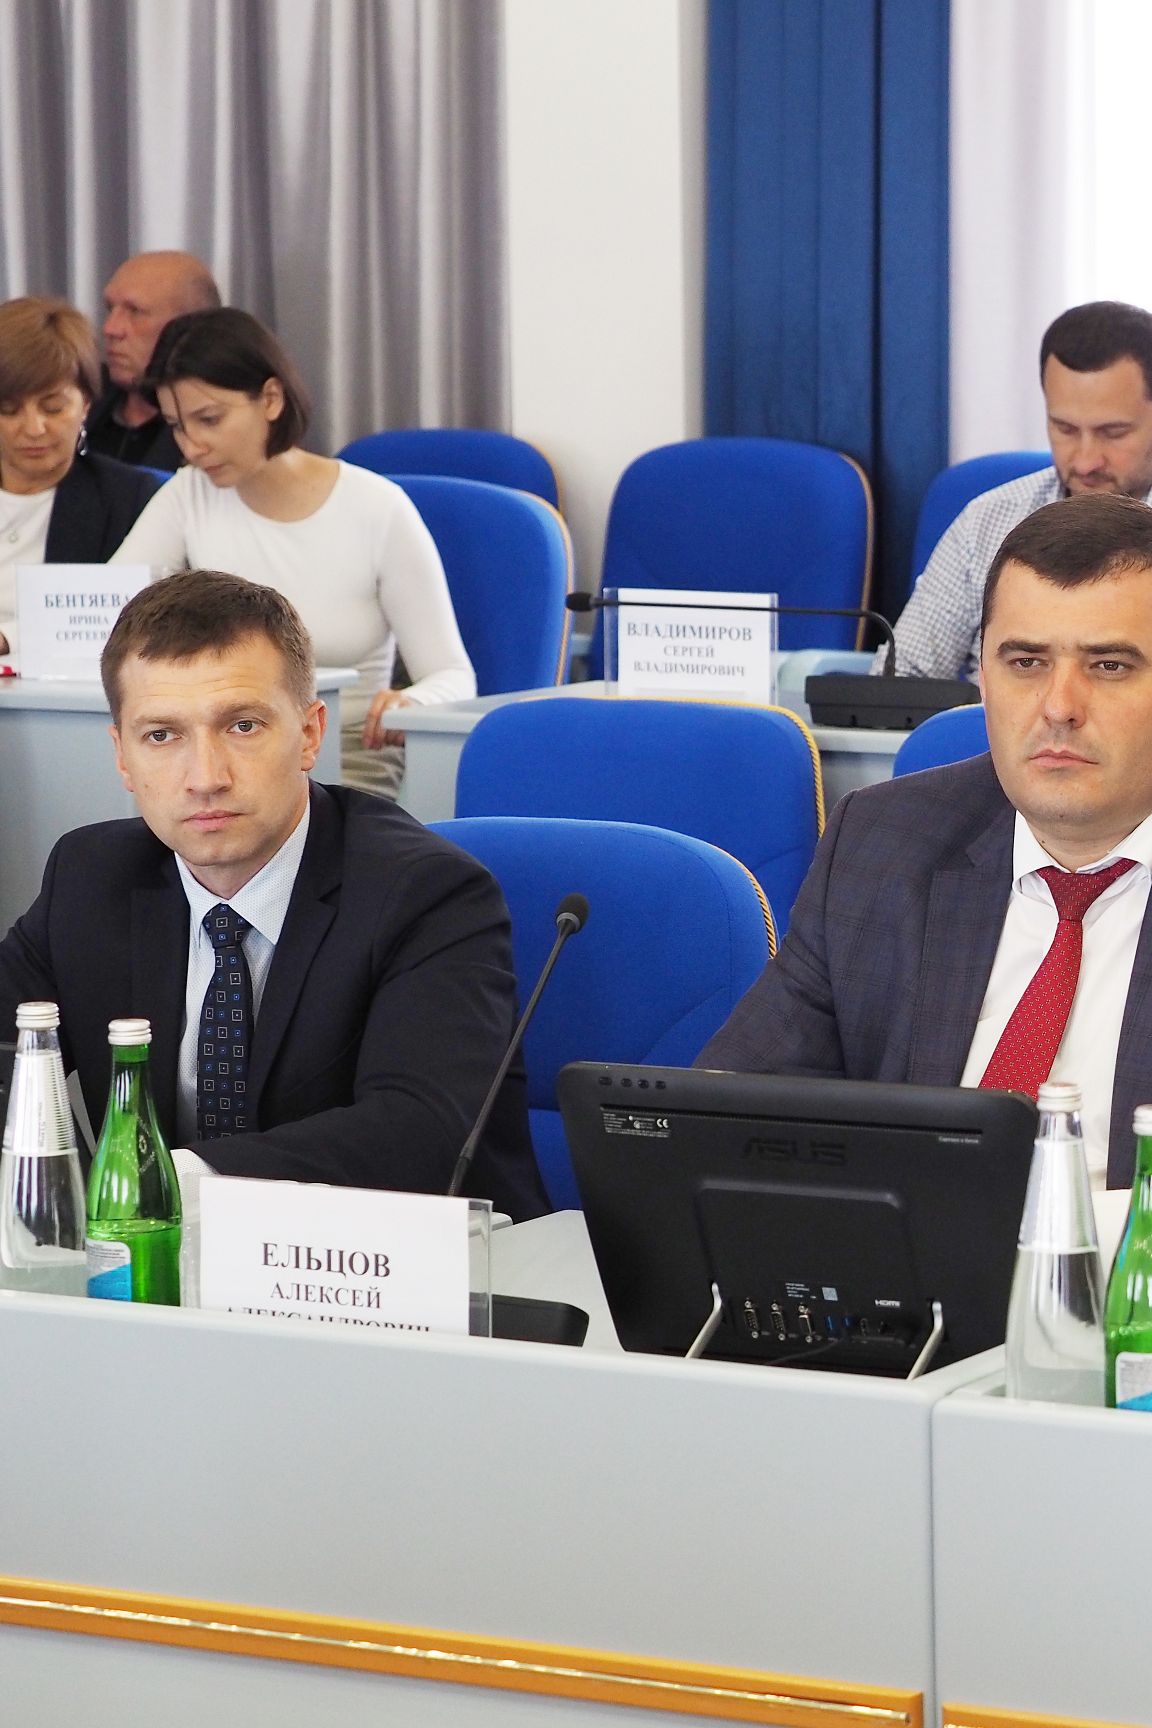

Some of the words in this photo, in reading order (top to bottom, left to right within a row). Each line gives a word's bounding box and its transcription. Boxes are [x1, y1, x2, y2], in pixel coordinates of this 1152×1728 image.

[69, 615, 109, 625] ИРИНА
[56, 631, 110, 641] СЕРГЕЕВ
[627, 622, 752, 641] ВЛАДИМИРОВ
[663, 645, 715, 658] СЕРГЕЙ
[633, 661, 745, 677] ВЛАДИМИРОВИЧ
[742, 1137, 845, 1164] ASUS
[262, 1242, 391, 1279] ЕЛЬЦОВ
[270, 1282, 382, 1309] АЛЕКСЕЙ
